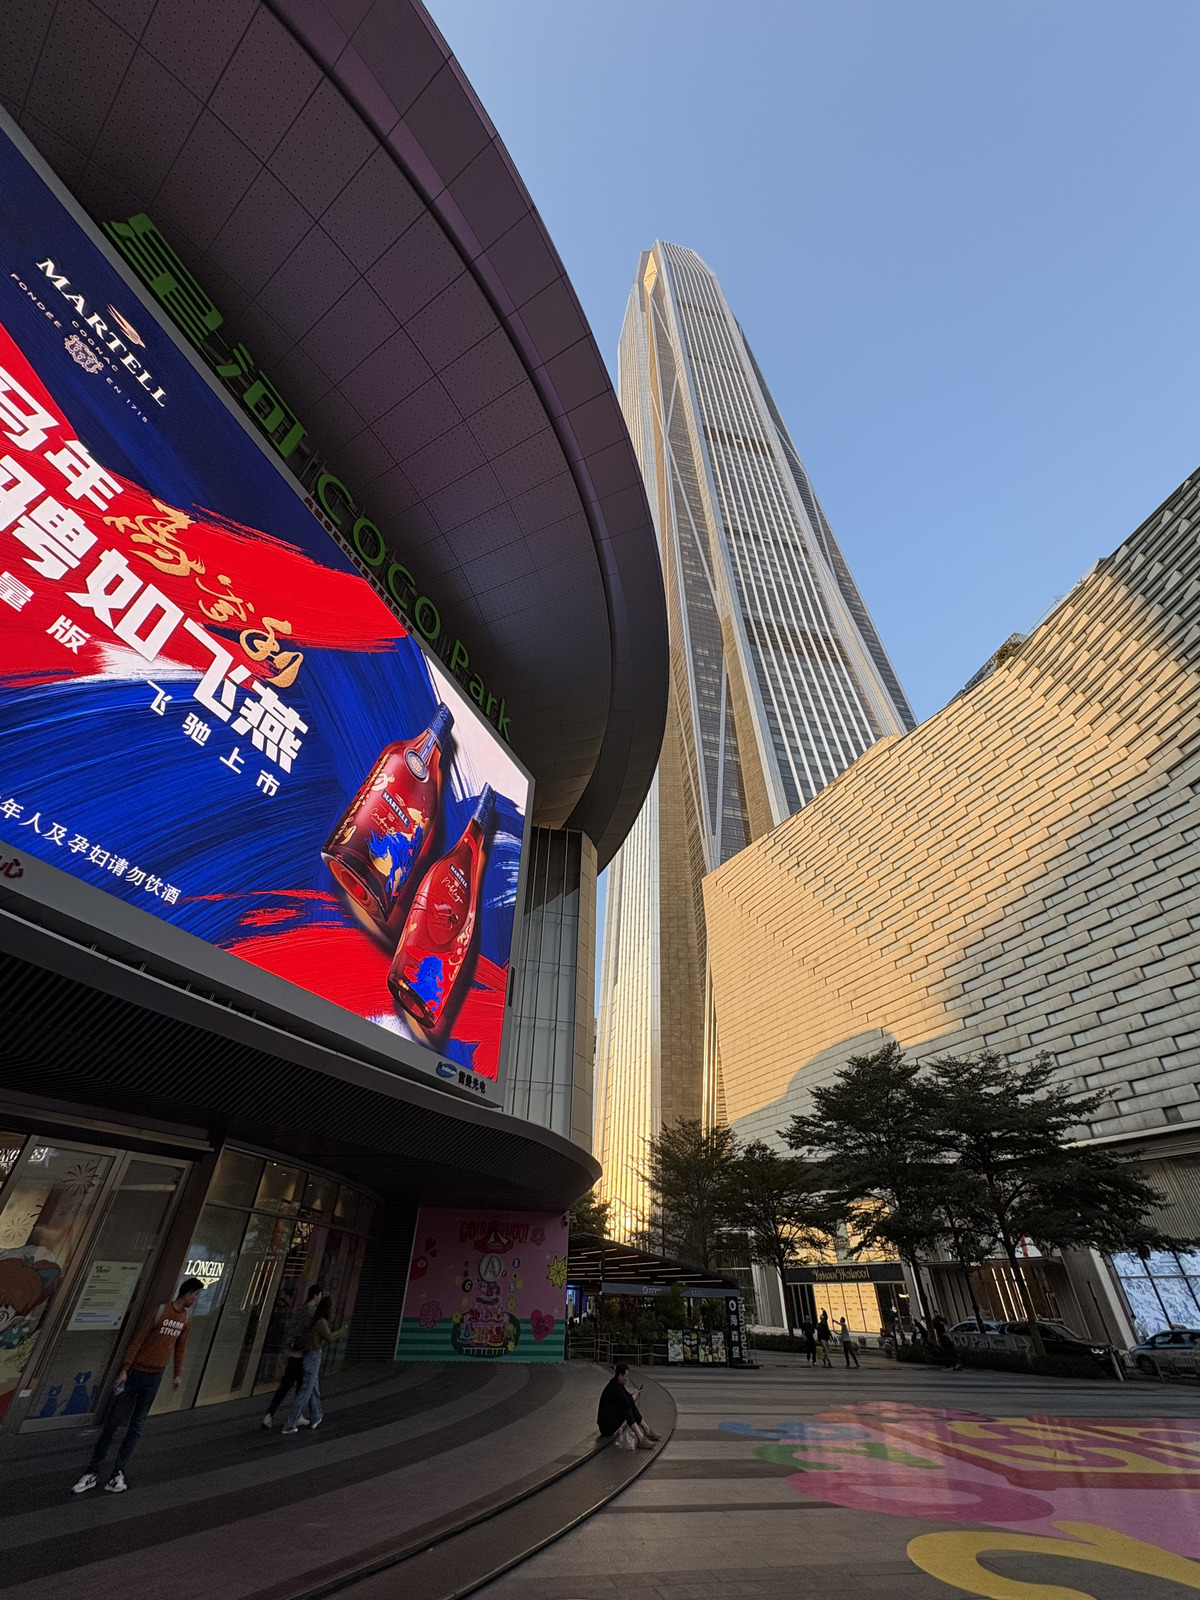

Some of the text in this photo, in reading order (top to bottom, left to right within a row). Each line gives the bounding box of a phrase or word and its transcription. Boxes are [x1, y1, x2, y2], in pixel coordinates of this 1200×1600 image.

[35, 257, 168, 407] MARTELL
[105, 377, 122, 394] EN
[125, 398, 148, 423] 1715
[0, 366, 123, 511] 马年
[315, 472, 511, 744] COCO Park
[147, 680, 281, 798] 飞驰上市
[382, 791, 409, 826] MARTELL
[0, 856, 24, 879] 心
[450, 865, 468, 889] MARTELL
[458, 1070, 486, 1094] 雷曼光电
